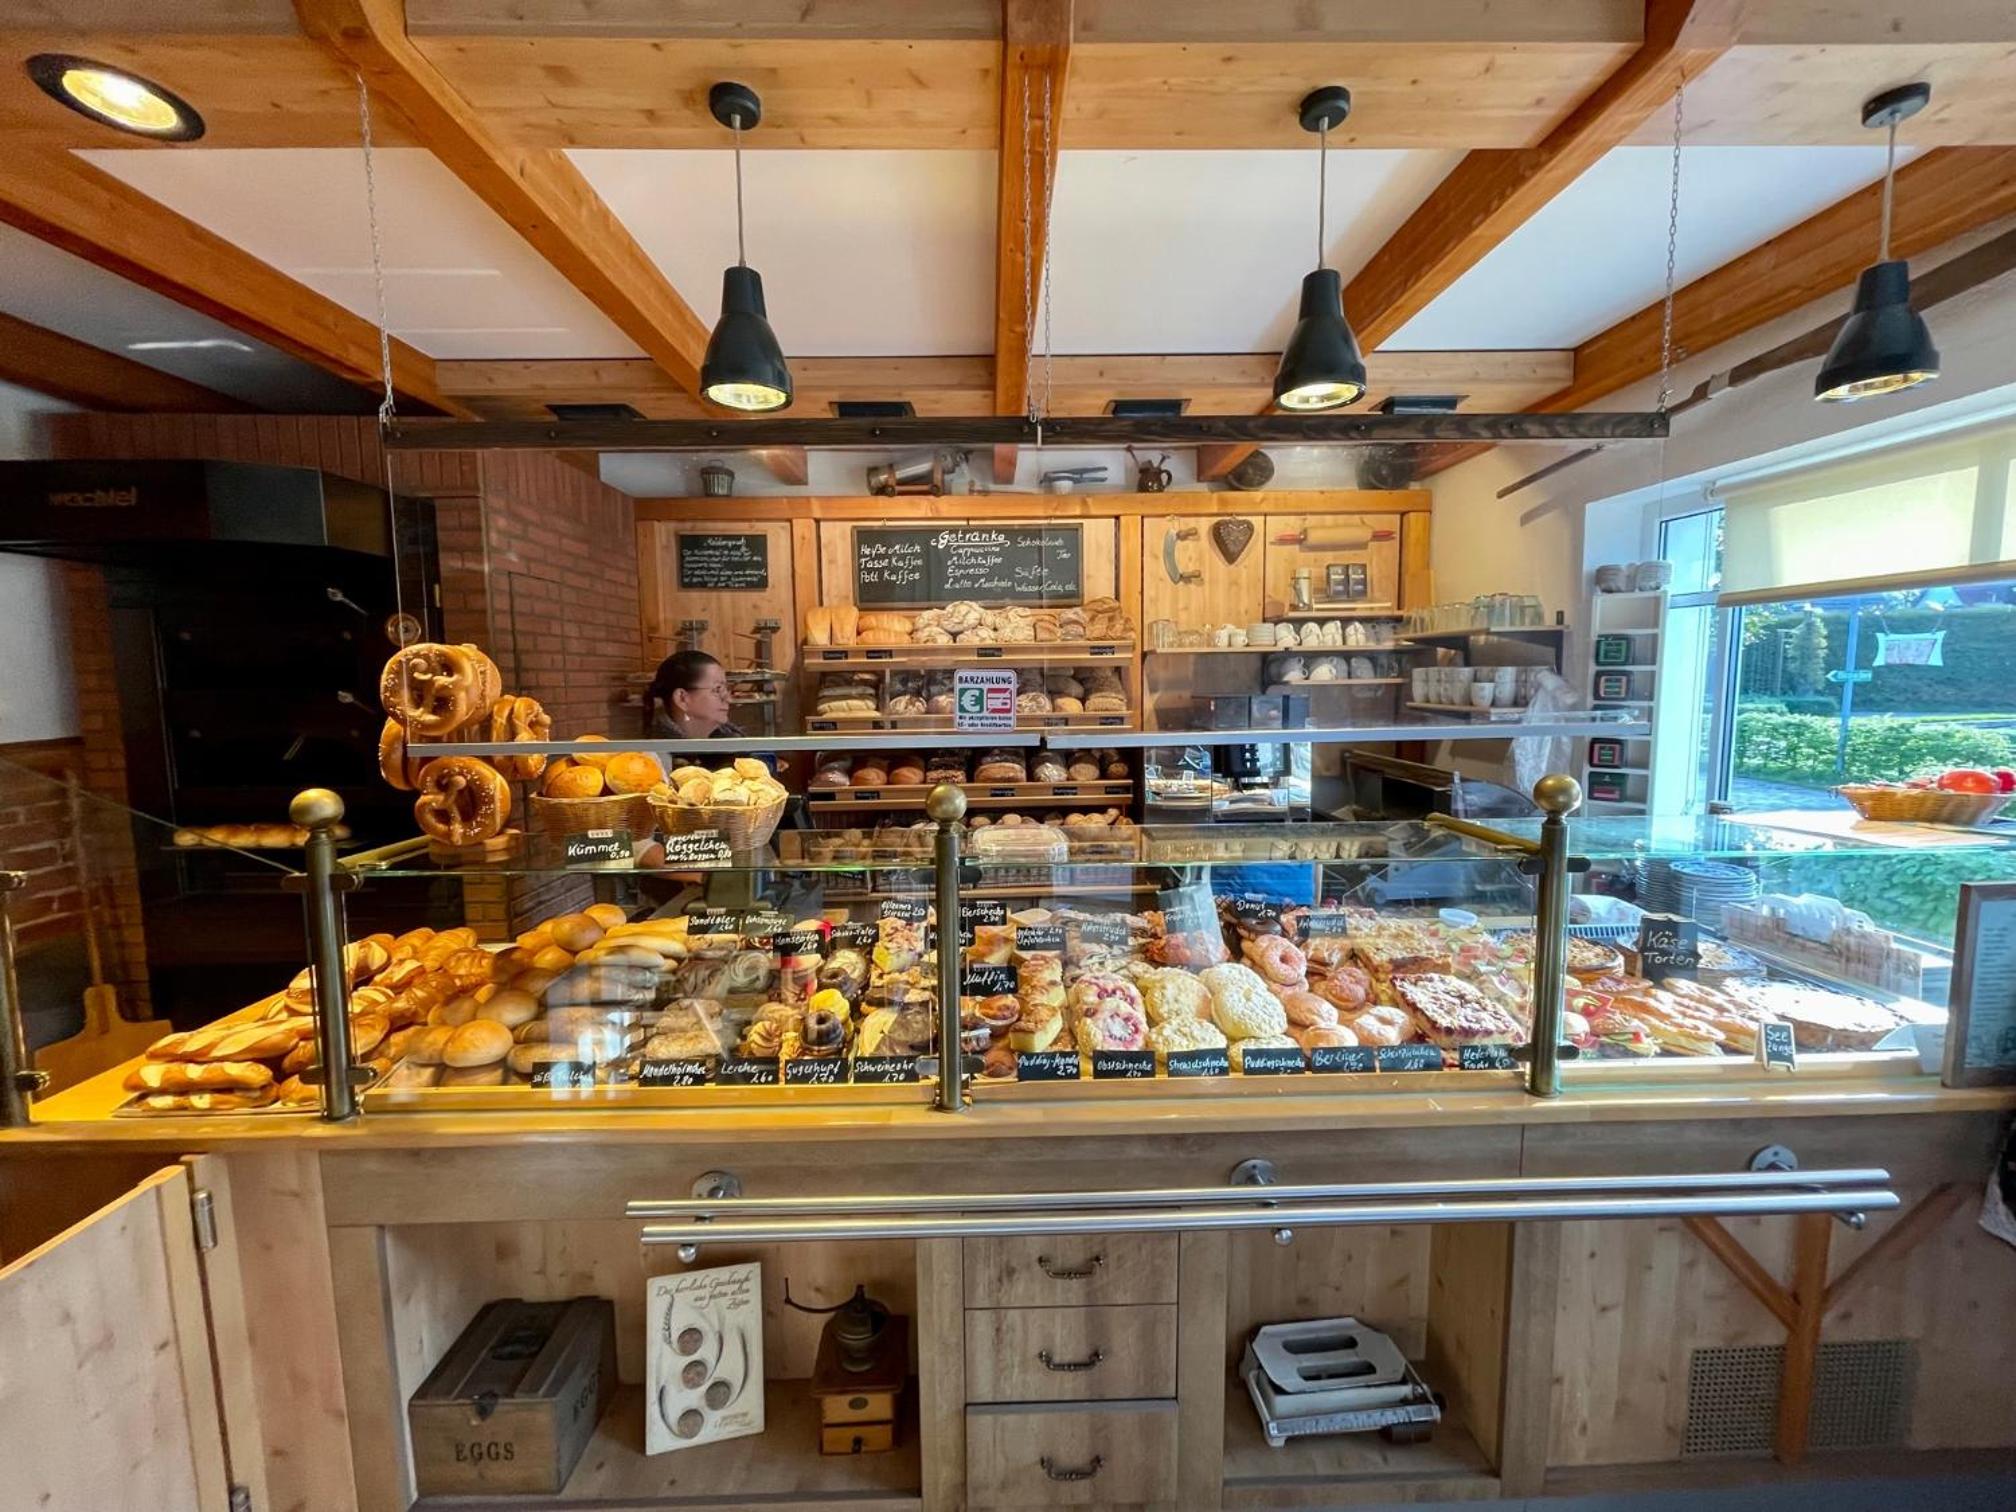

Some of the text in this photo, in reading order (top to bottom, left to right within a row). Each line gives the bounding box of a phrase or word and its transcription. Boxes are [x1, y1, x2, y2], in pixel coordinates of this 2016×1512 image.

[888, 543, 921, 555] Milch
[860, 556, 923, 569] Tasse Kaffee
[883, 570, 921, 584] Kaffee
[958, 676, 1012, 685] BARZAHLUNG
[568, 842, 620, 857] Kümmel
[1237, 900, 1266, 911] Donut
[1647, 931, 1689, 950] Käse
[1643, 951, 1696, 968] Torten
[963, 971, 1008, 986] Muffin
[1767, 1025, 1789, 1041] See
[1313, 1049, 1365, 1068] Berliner
[455, 1441, 515, 1462] EGGS
